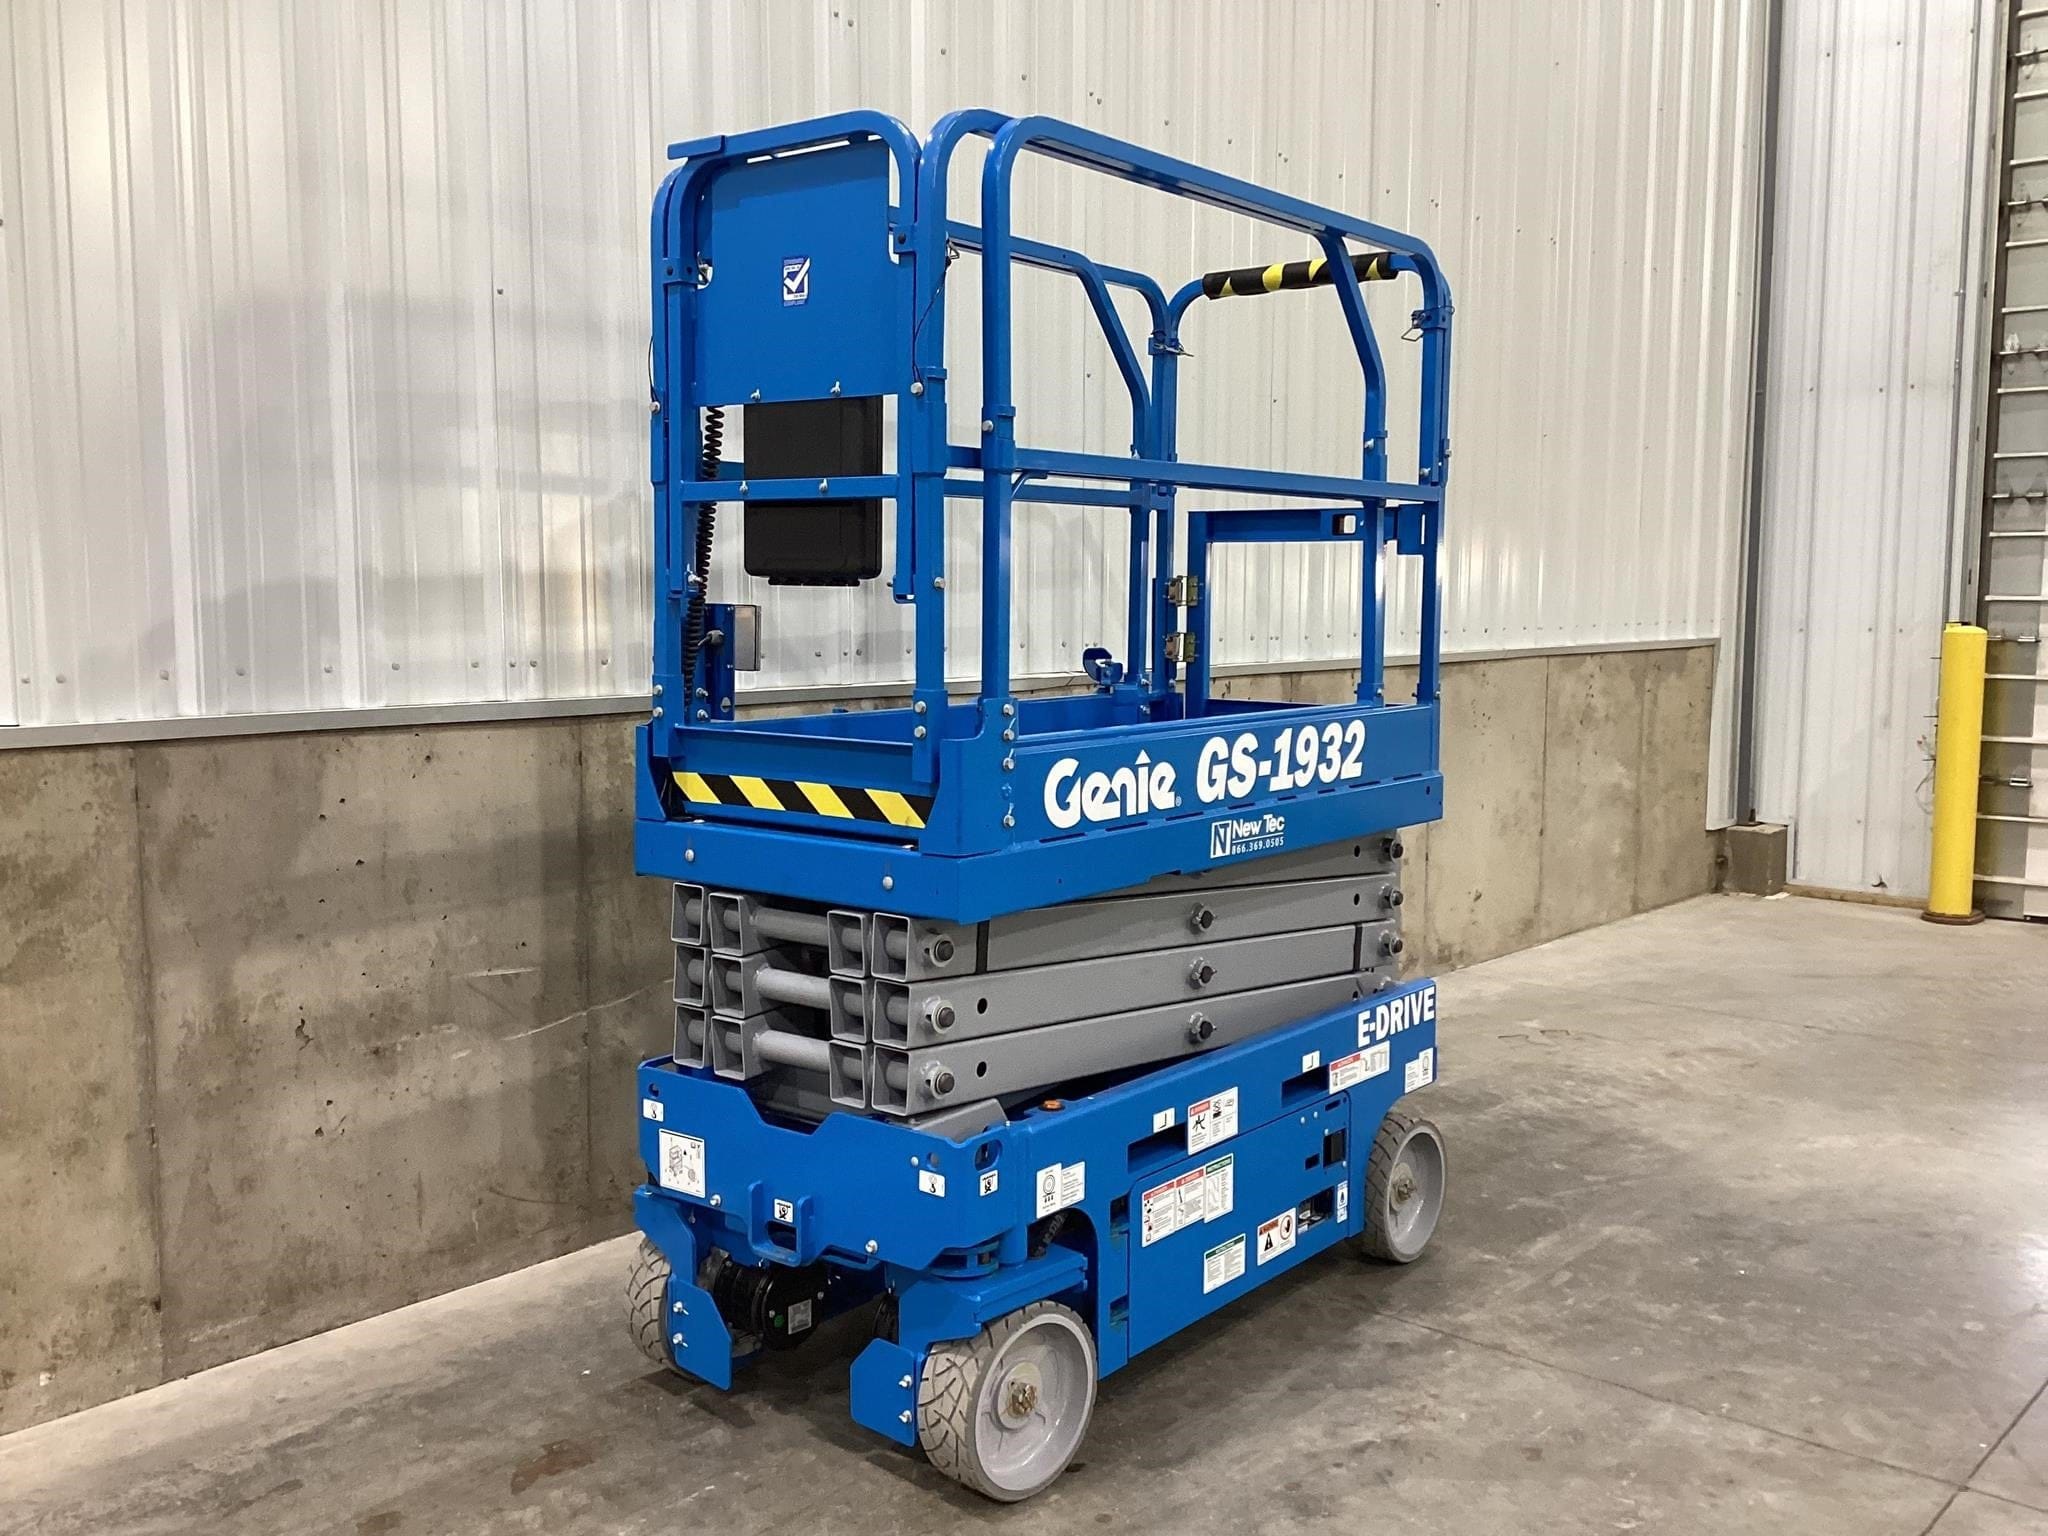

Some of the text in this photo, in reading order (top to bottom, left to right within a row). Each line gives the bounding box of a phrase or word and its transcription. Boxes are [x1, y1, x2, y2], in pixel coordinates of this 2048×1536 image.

[1044, 719, 1366, 829] Genie GS-1932
[1232, 814, 1285, 839] New Tec
[1358, 986, 1435, 1048] E-DRIVE
